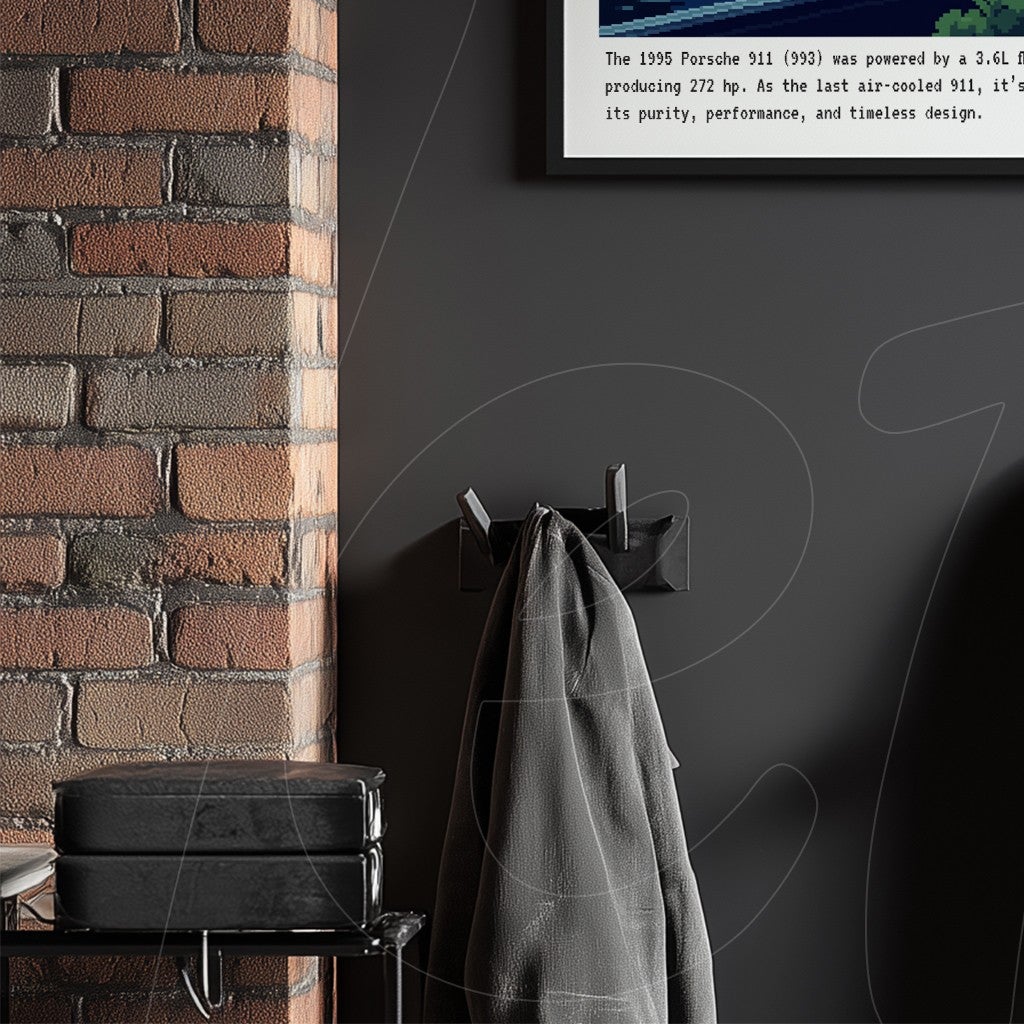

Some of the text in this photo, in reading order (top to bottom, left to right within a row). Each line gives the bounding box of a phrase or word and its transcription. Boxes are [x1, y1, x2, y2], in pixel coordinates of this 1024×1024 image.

[605, 51, 631, 66] The
[639, 51, 673, 66] 1995
[681, 51, 740, 66] Porsche
[748, 51, 774, 66] 911
[784, 48, 823, 68] (993)
[832, 54, 858, 66] was
[866, 50, 925, 69] powered
[933, 50, 951, 69] by
[958, 54, 968, 66] a
[975, 50, 1010, 66] 3.6L
[605, 78, 682, 97] producing
[689, 78, 715, 93] 272
[722, 78, 747, 97] hp.
[756, 78, 774, 93] As
[782, 78, 808, 93] the
[816, 78, 849, 93] last
[857, 78, 943, 93] air-cooled
[950, 78, 983, 97] 911,
[605, 105, 983, 124] its purity, performance, and timeless design.
